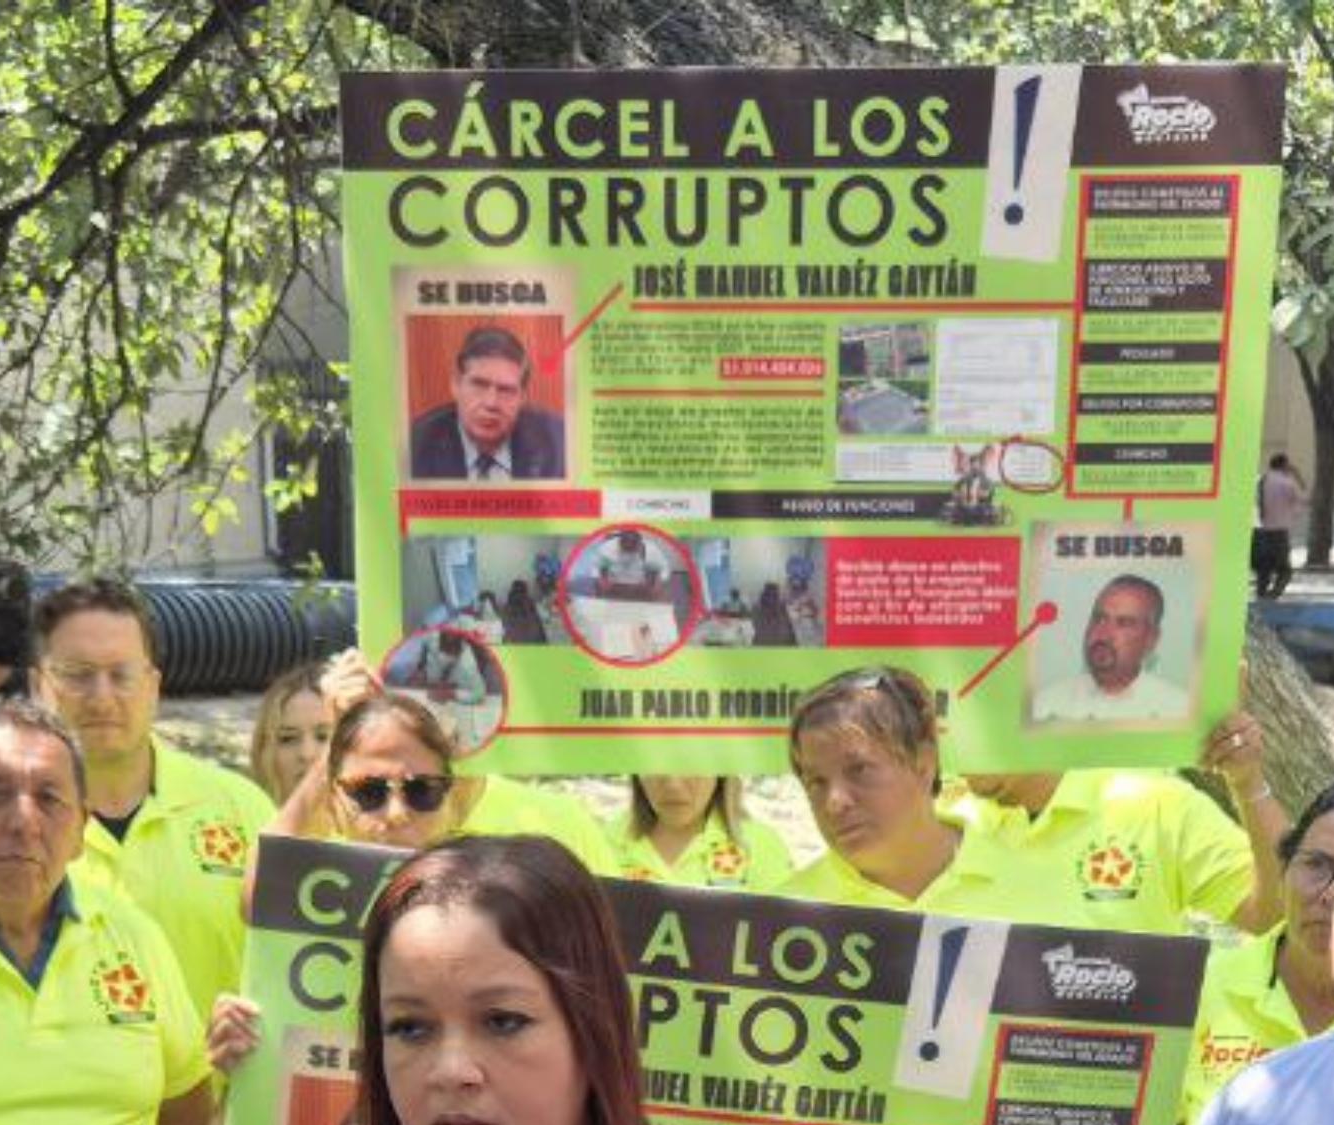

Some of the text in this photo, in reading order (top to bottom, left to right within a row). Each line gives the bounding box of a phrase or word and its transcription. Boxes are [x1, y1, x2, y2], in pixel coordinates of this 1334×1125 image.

[386, 81, 951, 159] CÁRCEL A LOS
[388, 174, 948, 247] CORRUPTOS
[417, 281, 547, 305] SE BUSCA
[633, 258, 977, 297] JOSÉ MANUEL VALDÉZ GAYTÁN
[1056, 536, 1183, 557] SE BUSCA
[580, 688, 634, 718] JUAN
[642, 688, 711, 718] PABLO
[641, 911, 875, 991] A LOS
[307, 1043, 341, 1069] SE
[702, 1075, 787, 1115] VALDÉZ
[794, 1085, 886, 1123] GAYTÁN
